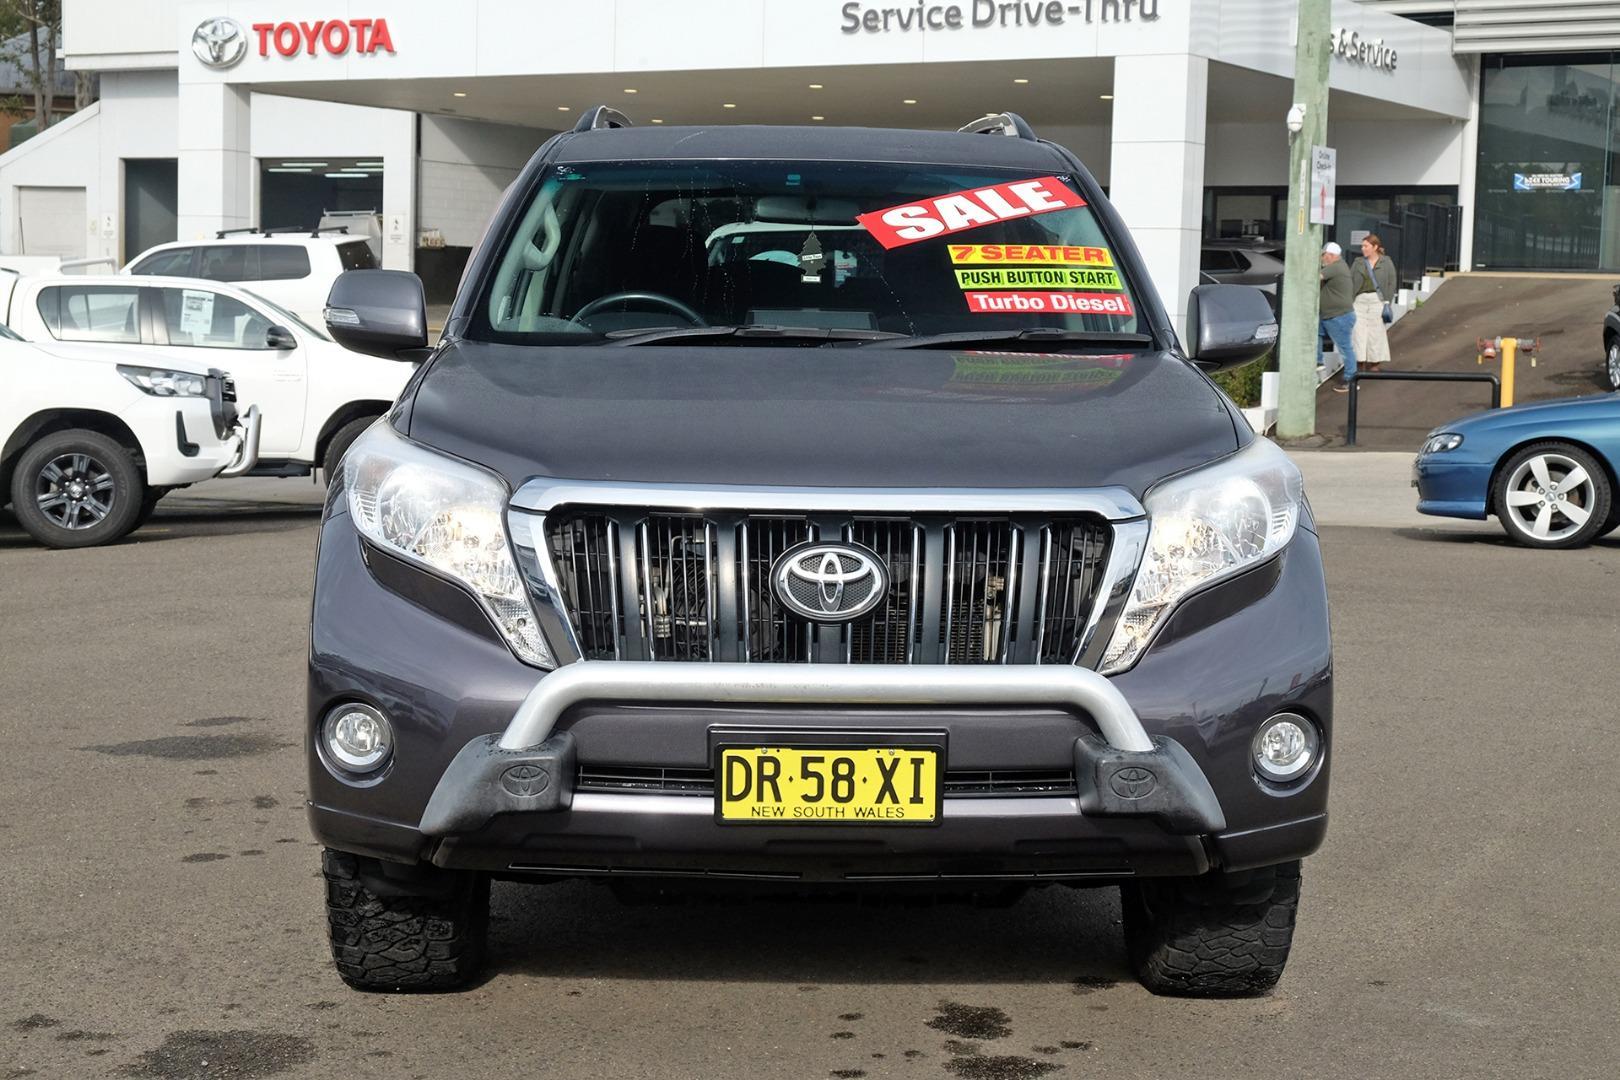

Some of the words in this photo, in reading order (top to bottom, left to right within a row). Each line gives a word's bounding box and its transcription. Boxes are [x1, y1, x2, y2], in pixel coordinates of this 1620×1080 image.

[841, 0, 963, 33] Service
[252, 18, 395, 57] TOYOTA
[1338, 28, 1348, 56] &
[1350, 31, 1397, 70] Service
[882, 181, 1068, 240] SALE
[952, 246, 974, 260] 7
[981, 245, 1106, 262] SEATER
[961, 271, 1002, 285] PUSH
[1007, 271, 1065, 285] BUTTON
[1069, 271, 1115, 285] START
[973, 294, 1045, 310] Turbo
[1049, 294, 1127, 312] Diesel
[751, 806, 786, 818] NEW
[793, 806, 845, 818] SOUTH
[854, 807, 905, 819] WALES
